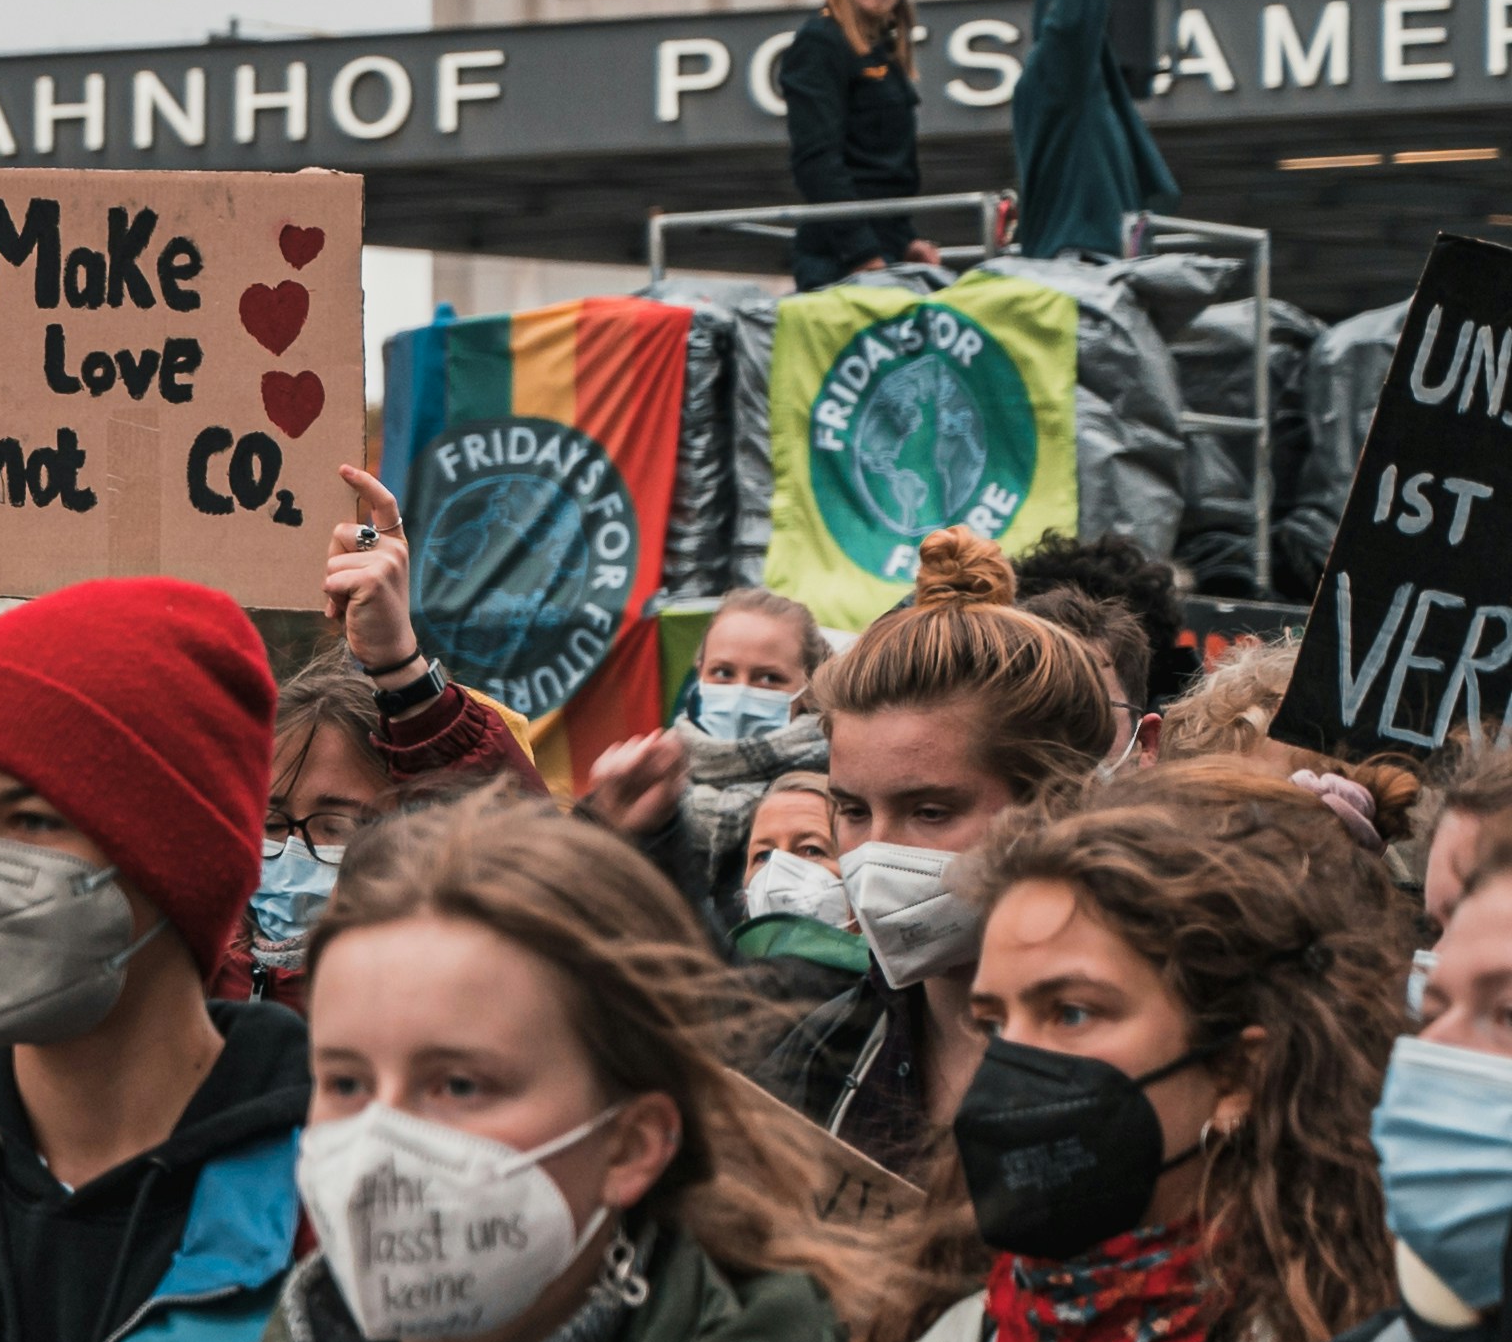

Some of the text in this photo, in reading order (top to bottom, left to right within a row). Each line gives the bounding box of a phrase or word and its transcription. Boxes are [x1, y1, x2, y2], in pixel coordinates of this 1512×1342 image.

[44, 322, 204, 404] Love
[1409, 303, 1512, 427] UN
[585, 490, 631, 592] FOR
[1373, 462, 1494, 546] IST
[1336, 571, 1512, 750] VER
